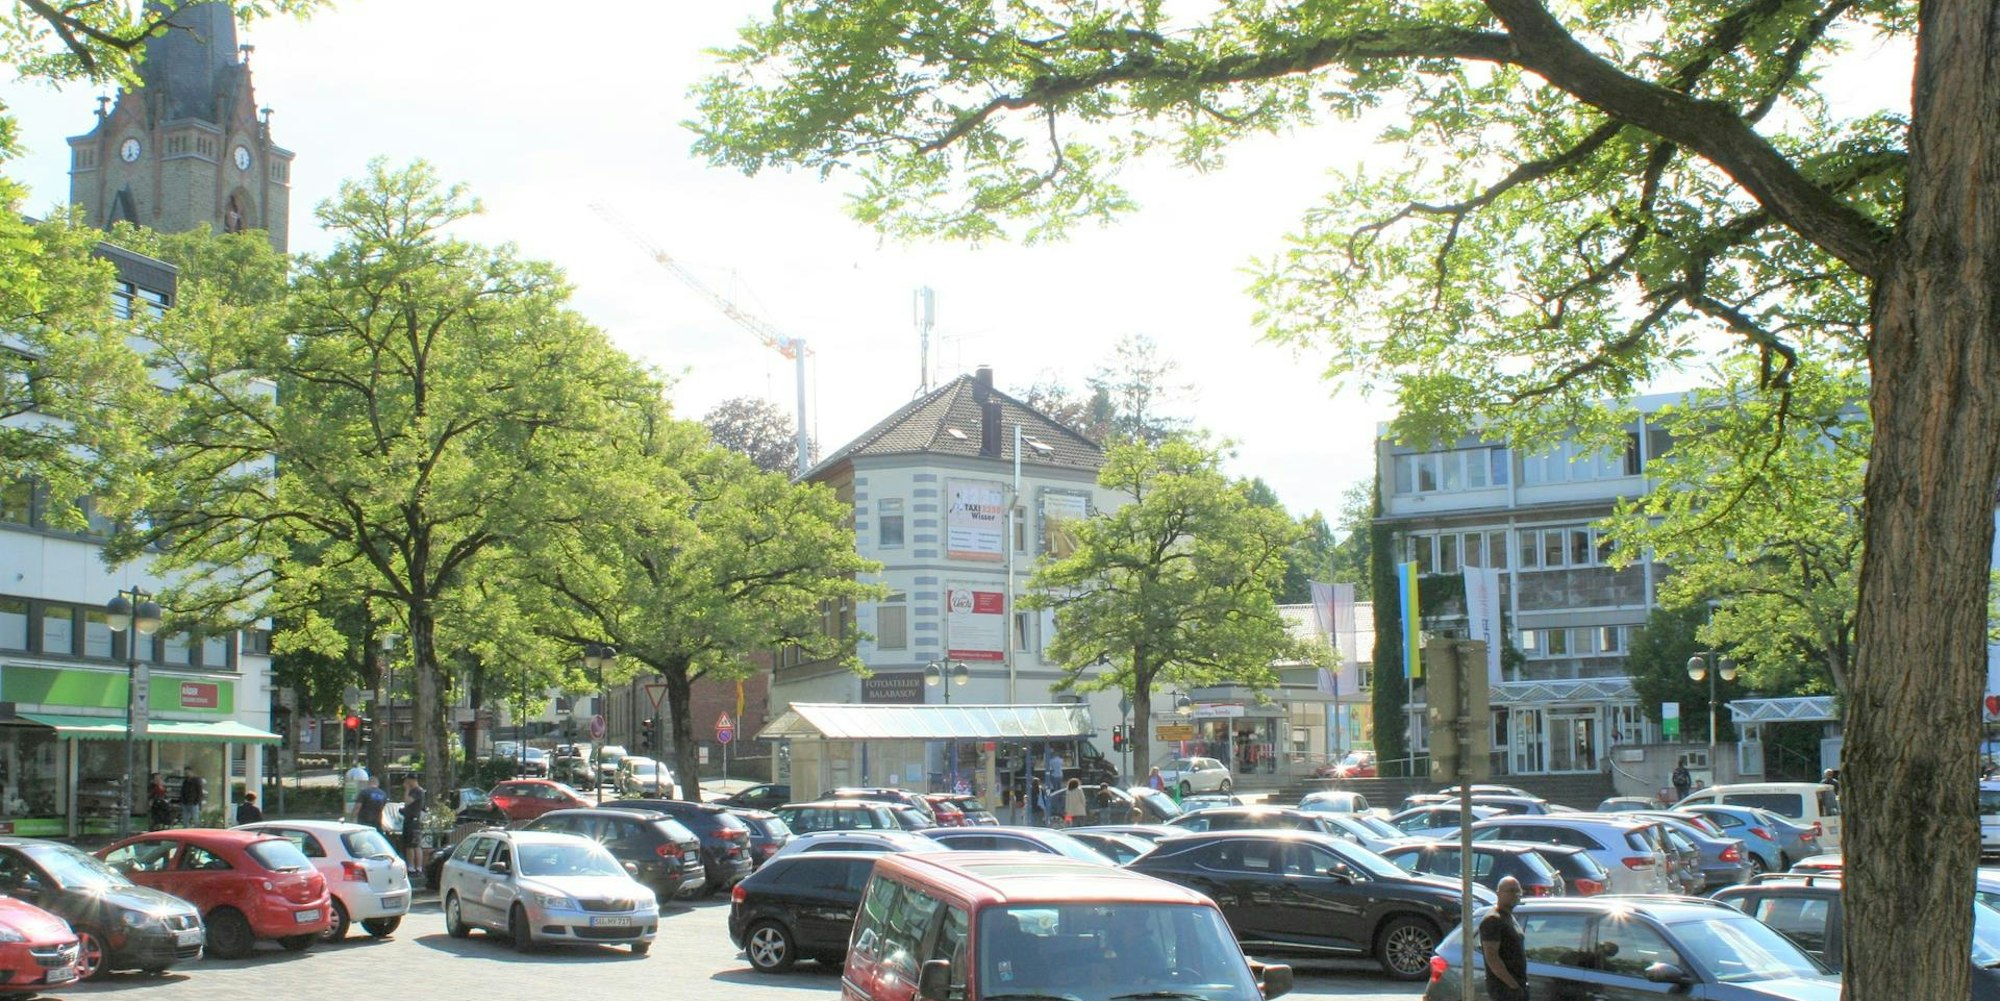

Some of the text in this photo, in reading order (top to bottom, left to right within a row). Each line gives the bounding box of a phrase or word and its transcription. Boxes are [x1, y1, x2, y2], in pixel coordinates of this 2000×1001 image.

[965, 503, 980, 511] TAXI
[971, 512, 995, 520] Wisser
[865, 679, 920, 688] FOTOATELIER
